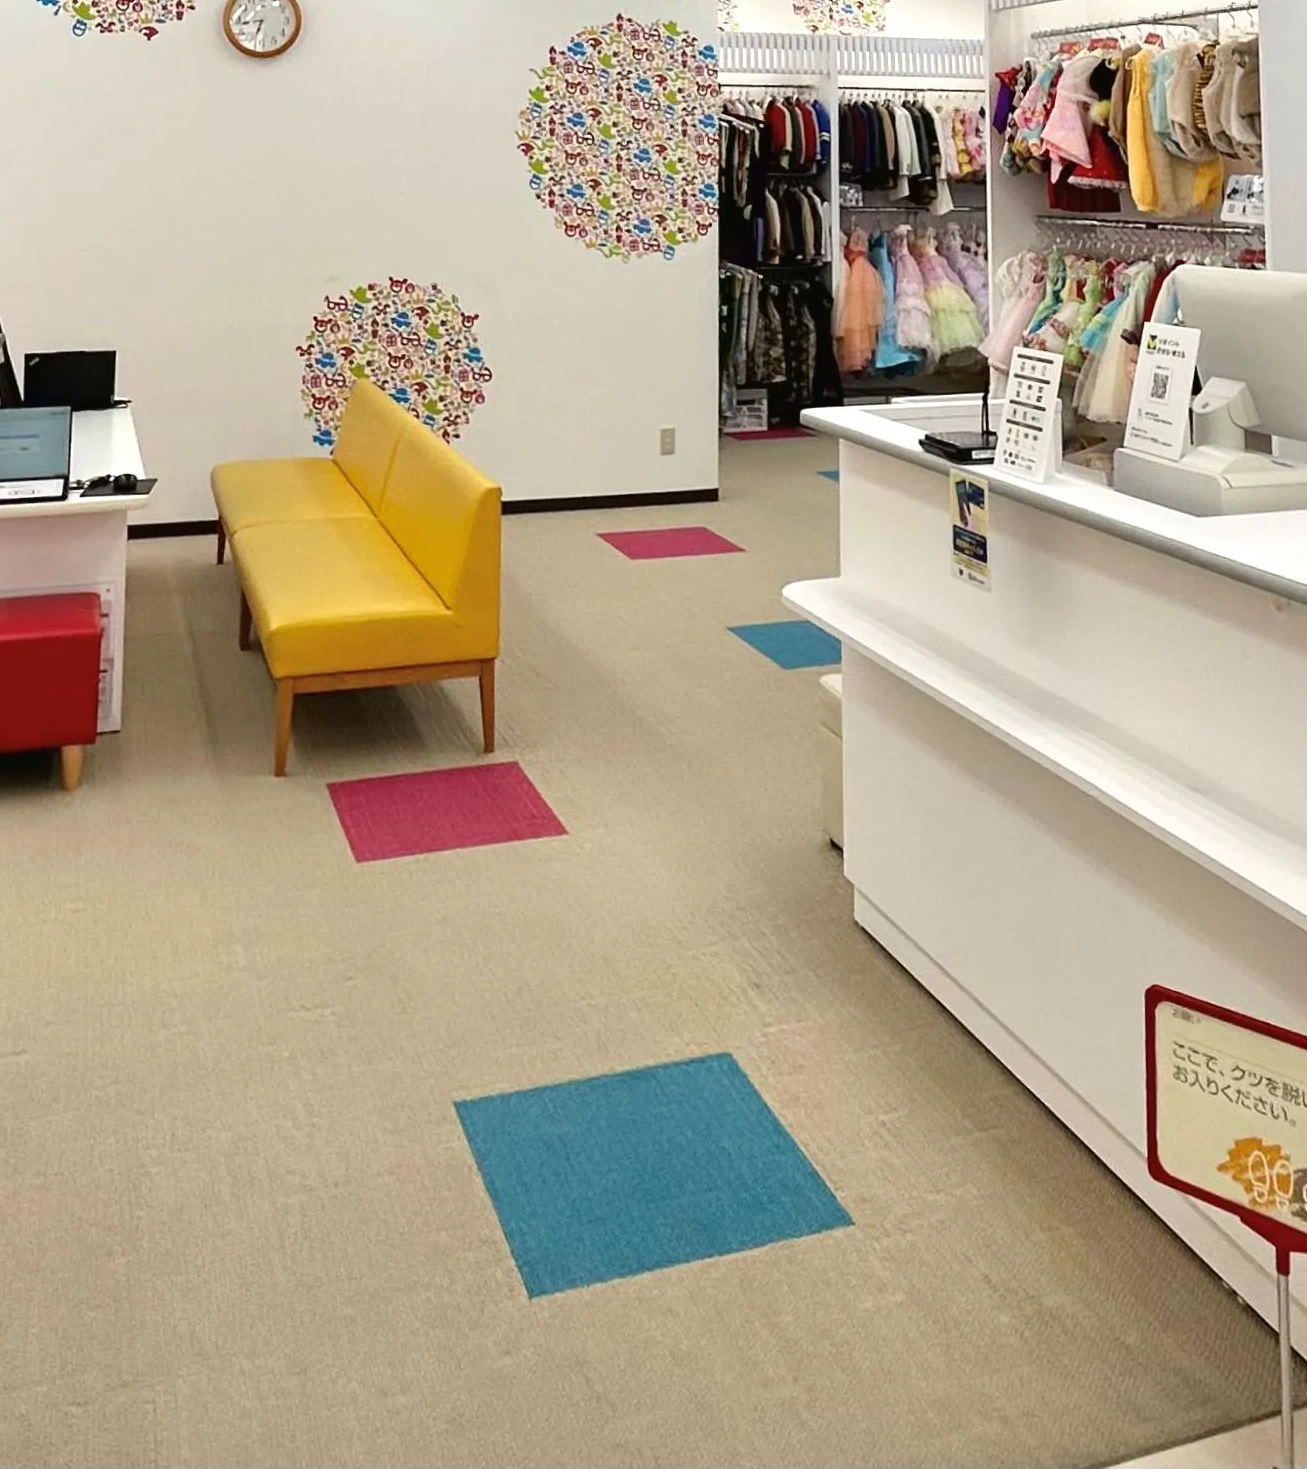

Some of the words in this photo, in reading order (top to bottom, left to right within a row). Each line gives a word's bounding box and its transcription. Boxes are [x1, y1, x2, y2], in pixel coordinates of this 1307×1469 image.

[1172, 1063, 1296, 1127] お入りください。
